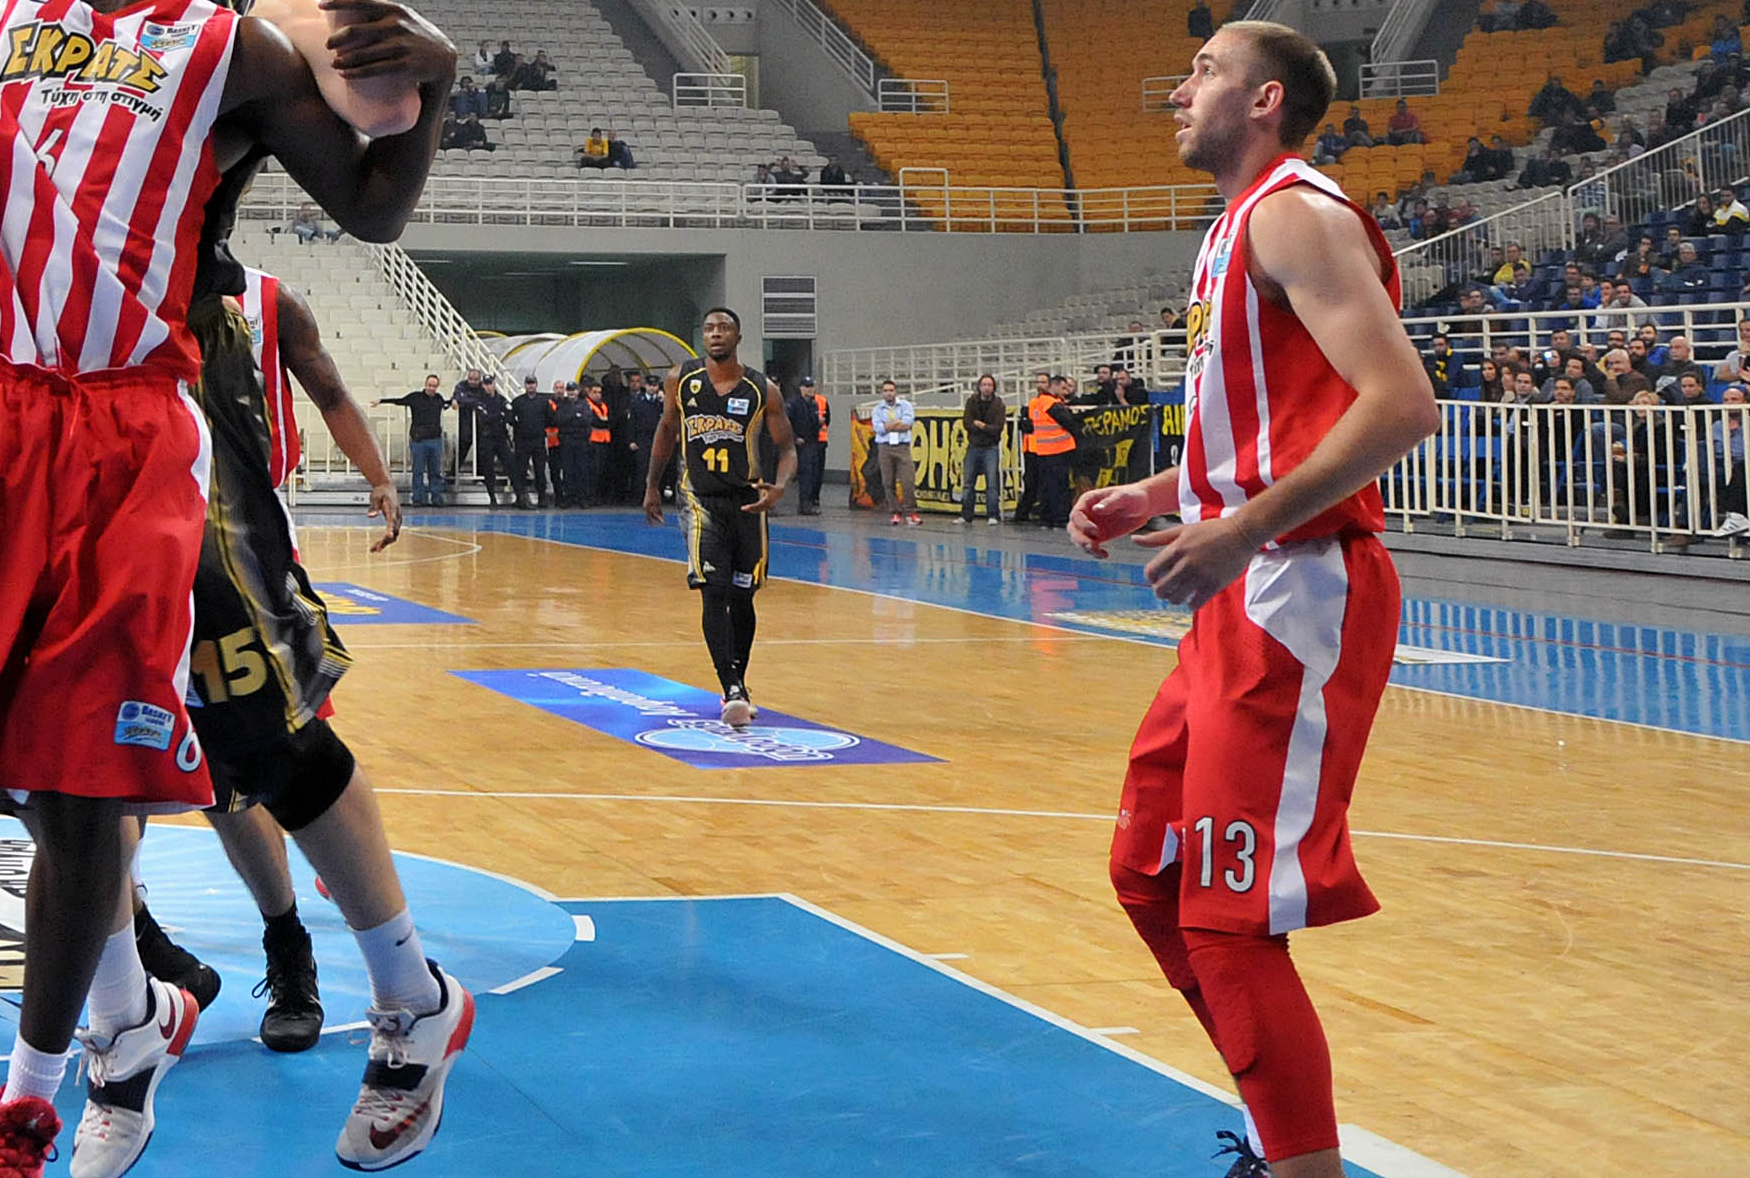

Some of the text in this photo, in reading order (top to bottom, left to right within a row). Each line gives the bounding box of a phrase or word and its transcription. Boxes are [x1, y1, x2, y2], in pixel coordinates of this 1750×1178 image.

[0, 21, 167, 93] ΣΚΡΑΤΣ
[702, 448, 729, 473] 11
[191, 626, 268, 704] 15
[1194, 816, 1256, 893] 13
